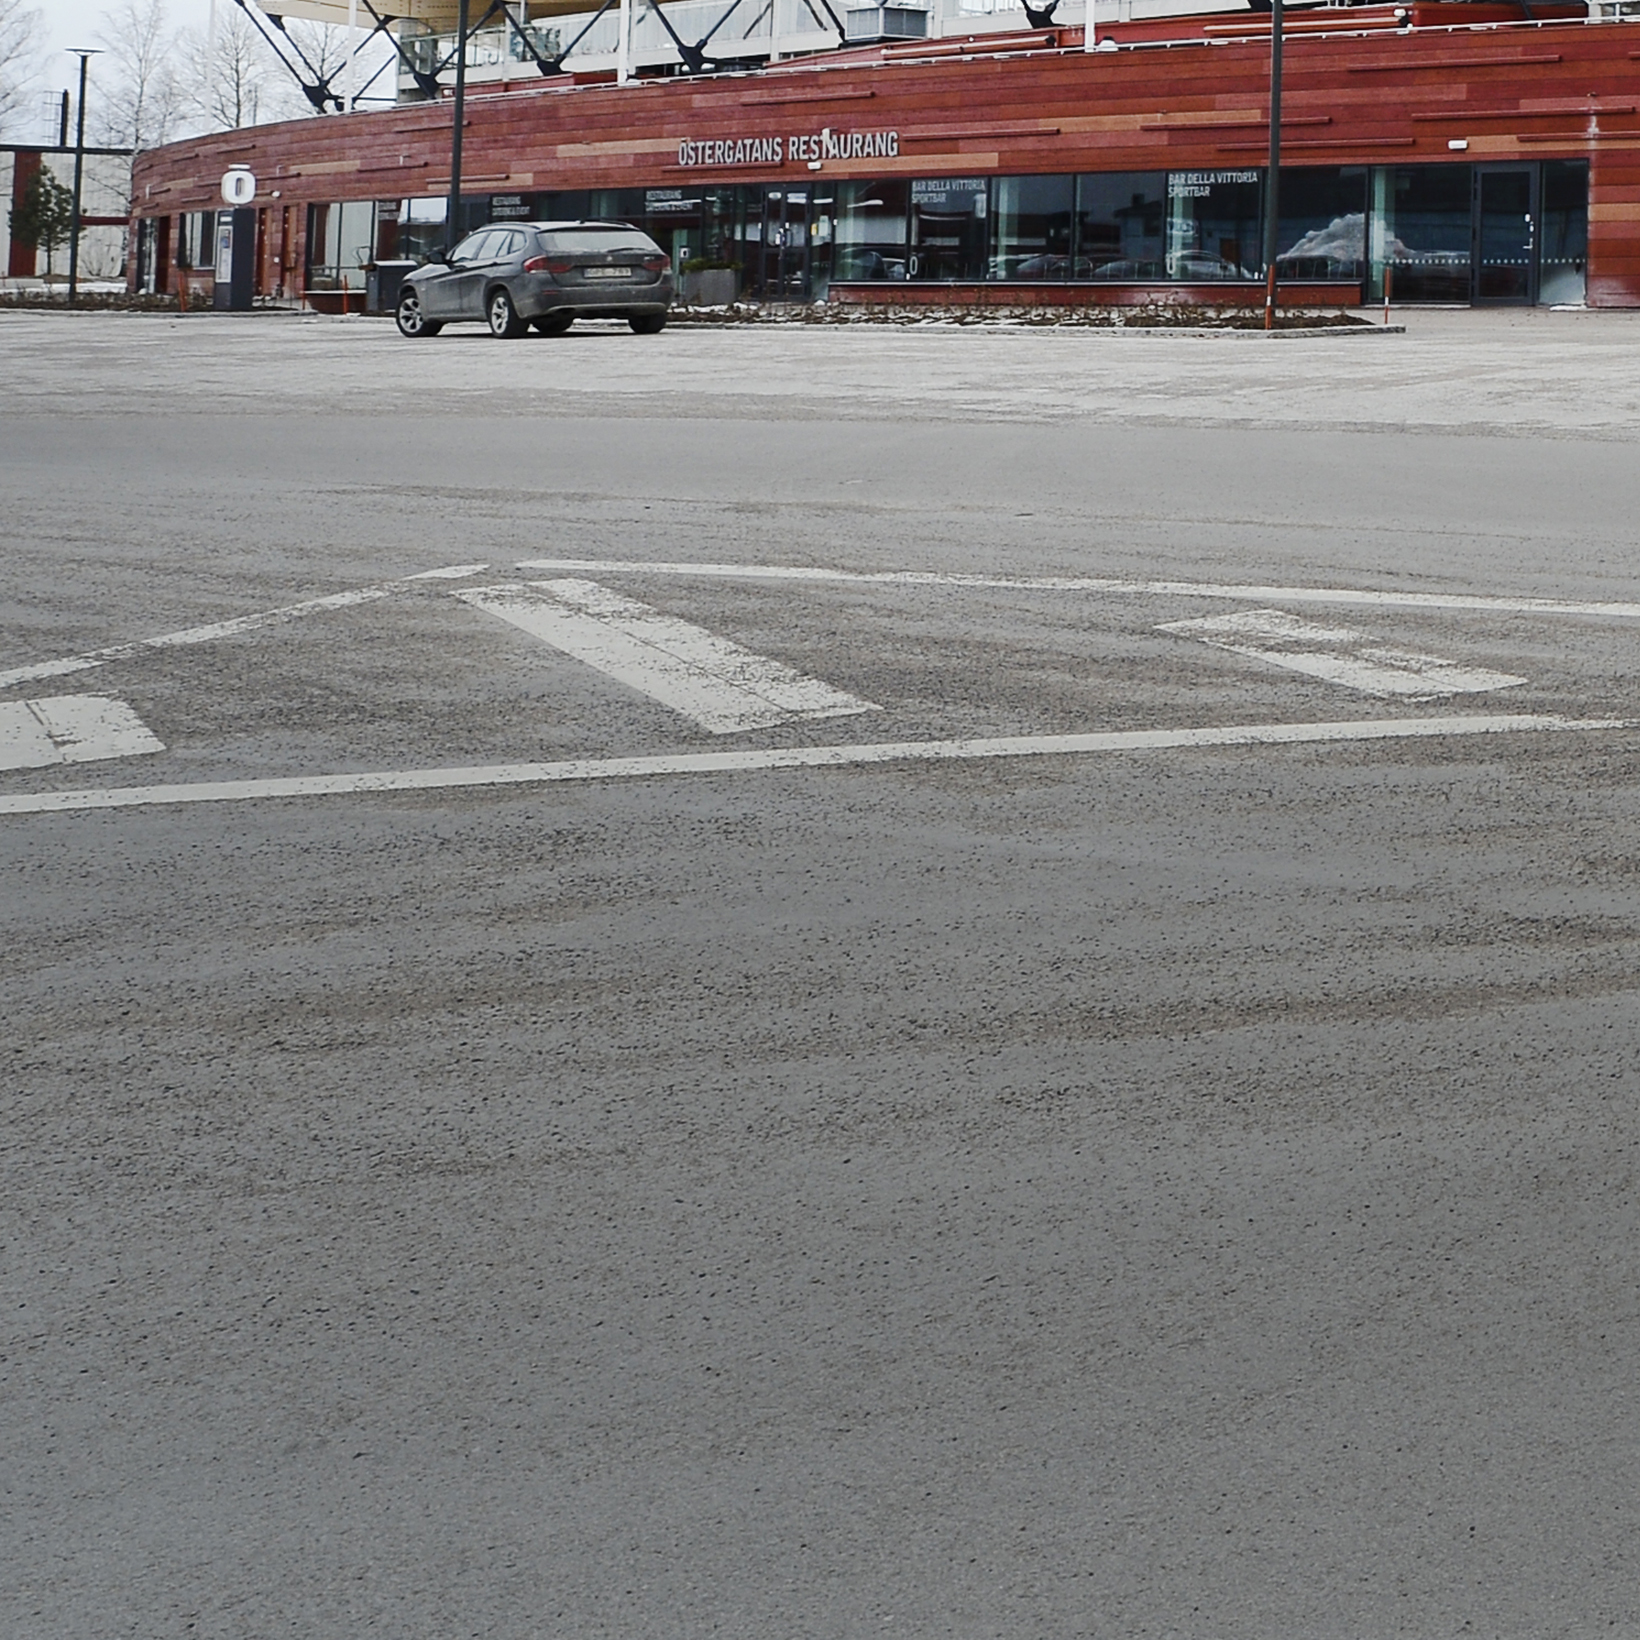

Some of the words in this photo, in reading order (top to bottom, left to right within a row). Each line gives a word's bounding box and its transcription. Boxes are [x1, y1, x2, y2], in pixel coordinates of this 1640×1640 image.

[678, 138, 782, 166] ÖSTERGATANS
[788, 131, 898, 160] RESTAURANG
[1168, 174, 1186, 185] BAR
[1188, 173, 1215, 184] DELLA
[1217, 172, 1258, 183] VITTORIA
[913, 181, 926, 191] BAR
[1168, 186, 1210, 198] SPORTBAR
